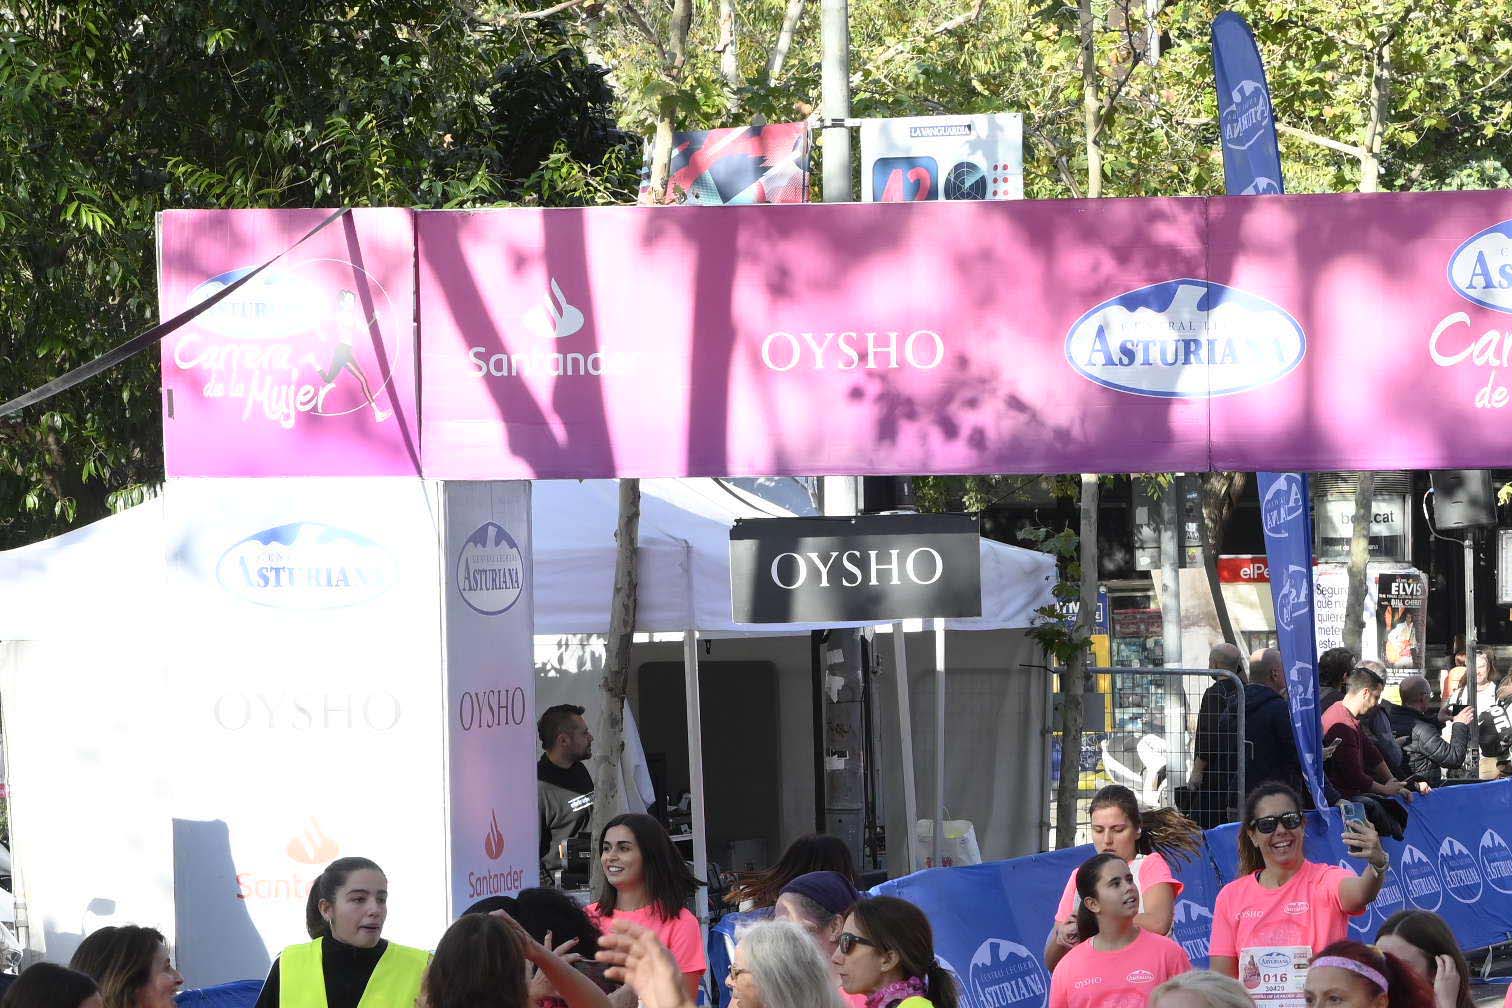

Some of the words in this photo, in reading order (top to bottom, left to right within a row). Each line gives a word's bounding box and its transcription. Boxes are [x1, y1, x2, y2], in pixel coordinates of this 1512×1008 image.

[922, 125, 971, 137] VANGUARDIA
[174, 333, 291, 370] Carrera
[761, 330, 944, 372] OYSHO
[241, 365, 337, 430] Mujer
[1474, 368, 1511, 409] de
[461, 557, 521, 594] ASTURIANA
[769, 546, 944, 592] OYSHO
[1391, 583, 1423, 596] ELVIS
[213, 690, 402, 732] OYSHO
[458, 686, 526, 732] OYSHO
[467, 865, 524, 899] Santander
[1262, 972, 1288, 984] 016
